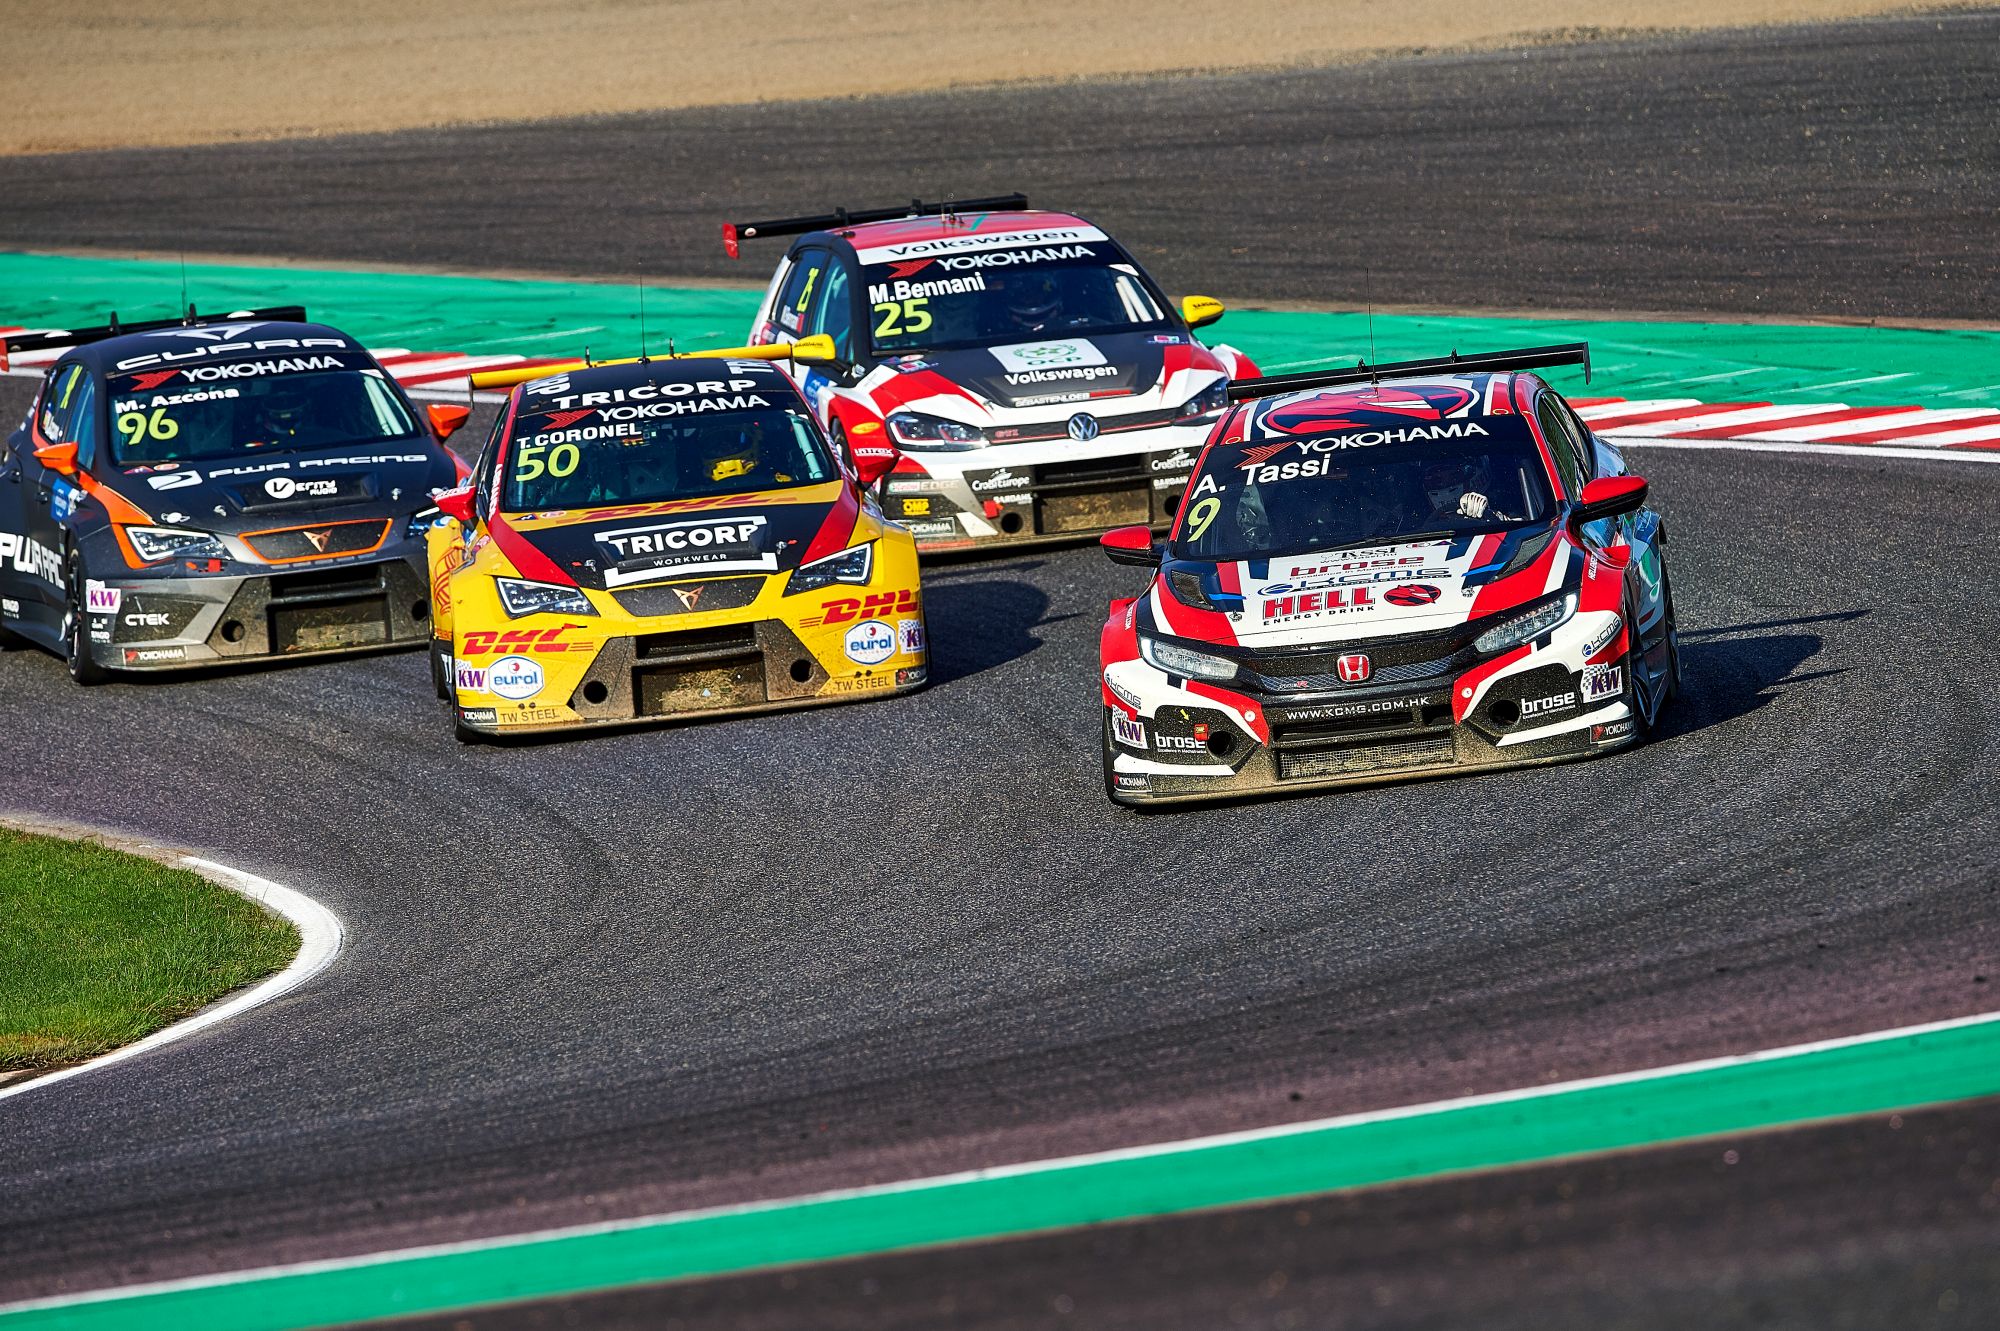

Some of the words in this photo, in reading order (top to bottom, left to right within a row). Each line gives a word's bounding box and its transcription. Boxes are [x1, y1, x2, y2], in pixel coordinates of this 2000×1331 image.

[888, 230, 1079, 255] Volkswagen
[936, 245, 1096, 272] YOKOHAMA
[873, 297, 933, 338] 25
[116, 338, 347, 370] CUPRA
[180, 355, 345, 383] YOKOHAMA
[1004, 364, 1119, 387] Volkswagen
[115, 398, 146, 413] M.
[151, 387, 240, 407] Azcona
[552, 379, 757, 410] TRICORP
[597, 394, 771, 423] YOKOHAMA
[117, 407, 179, 446] 96
[1296, 422, 1489, 456] YOKOHAMA
[209, 462, 291, 479] PWR
[300, 454, 428, 468] RACING
[515, 443, 581, 482] 50
[1191, 473, 1226, 501] A.
[1240, 453, 1330, 487] Tassi
[1187, 497, 1221, 543] 9
[608, 524, 758, 556] TRICORP
[653, 553, 727, 567] WORKWEAR
[1290, 556, 1424, 577] brose
[90, 590, 118, 607] KW
[820, 589, 919, 626] DHL
[1262, 586, 1375, 620] HELL
[125, 613, 169, 626] CTEK
[1263, 610, 1321, 626] ENERGY
[1328, 605, 1375, 615] DRINK
[462, 625, 571, 656] DHL
[850, 634, 892, 652] eurol
[137, 649, 184, 660] YOKOHAMA
[458, 669, 486, 688] KW
[493, 671, 538, 686] eurol
[835, 680, 853, 692] TW
[855, 676, 890, 690] STEEL
[1590, 668, 1621, 696] KW
[501, 712, 518, 723] TW
[521, 708, 561, 722] STEEL
[1286, 696, 1431, 721] WWW.KCMG.COM.HK
[1521, 691, 1576, 715] brose
[1118, 718, 1143, 742] KW
[1154, 731, 1206, 749] brose
